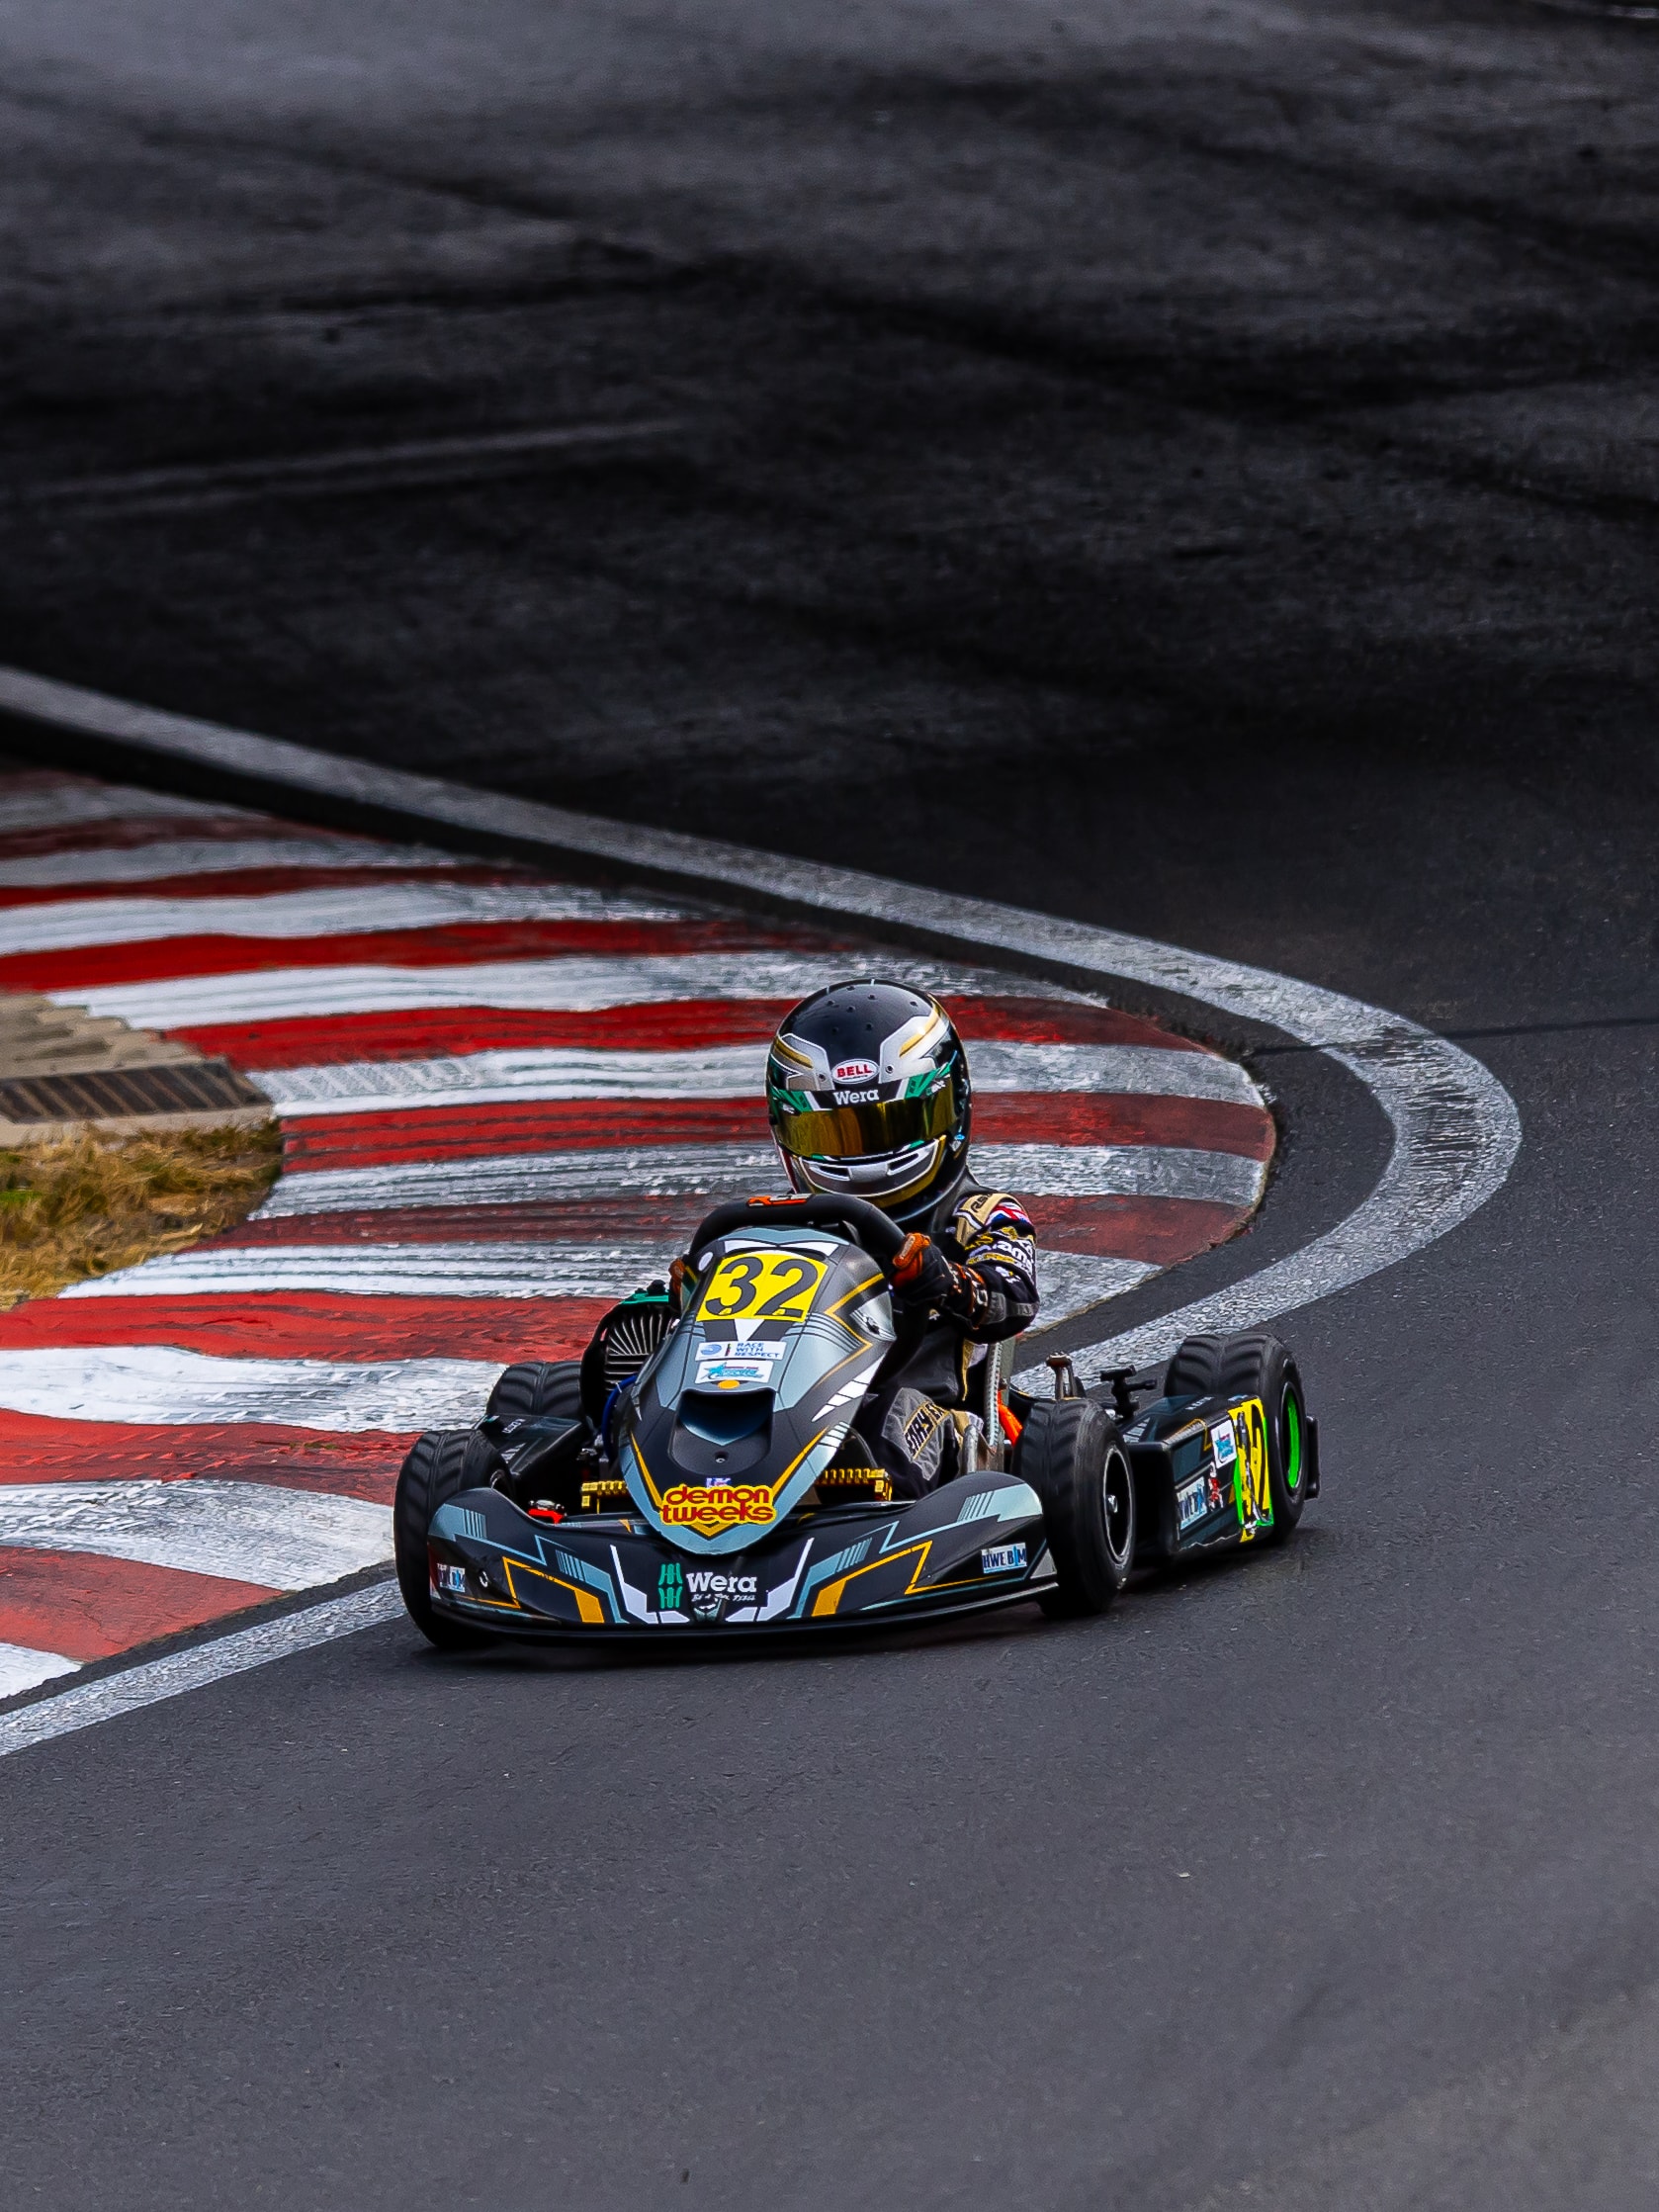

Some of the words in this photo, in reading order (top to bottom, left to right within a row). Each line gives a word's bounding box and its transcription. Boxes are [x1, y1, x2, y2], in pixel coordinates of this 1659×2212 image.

[837, 1064, 873, 1078] BELL
[833, 1090, 879, 1105] Wera
[705, 1256, 819, 1318] 32
[665, 1486, 769, 1506] demon
[662, 1504, 773, 1523] tweeks
[686, 1572, 757, 1592] Wera
